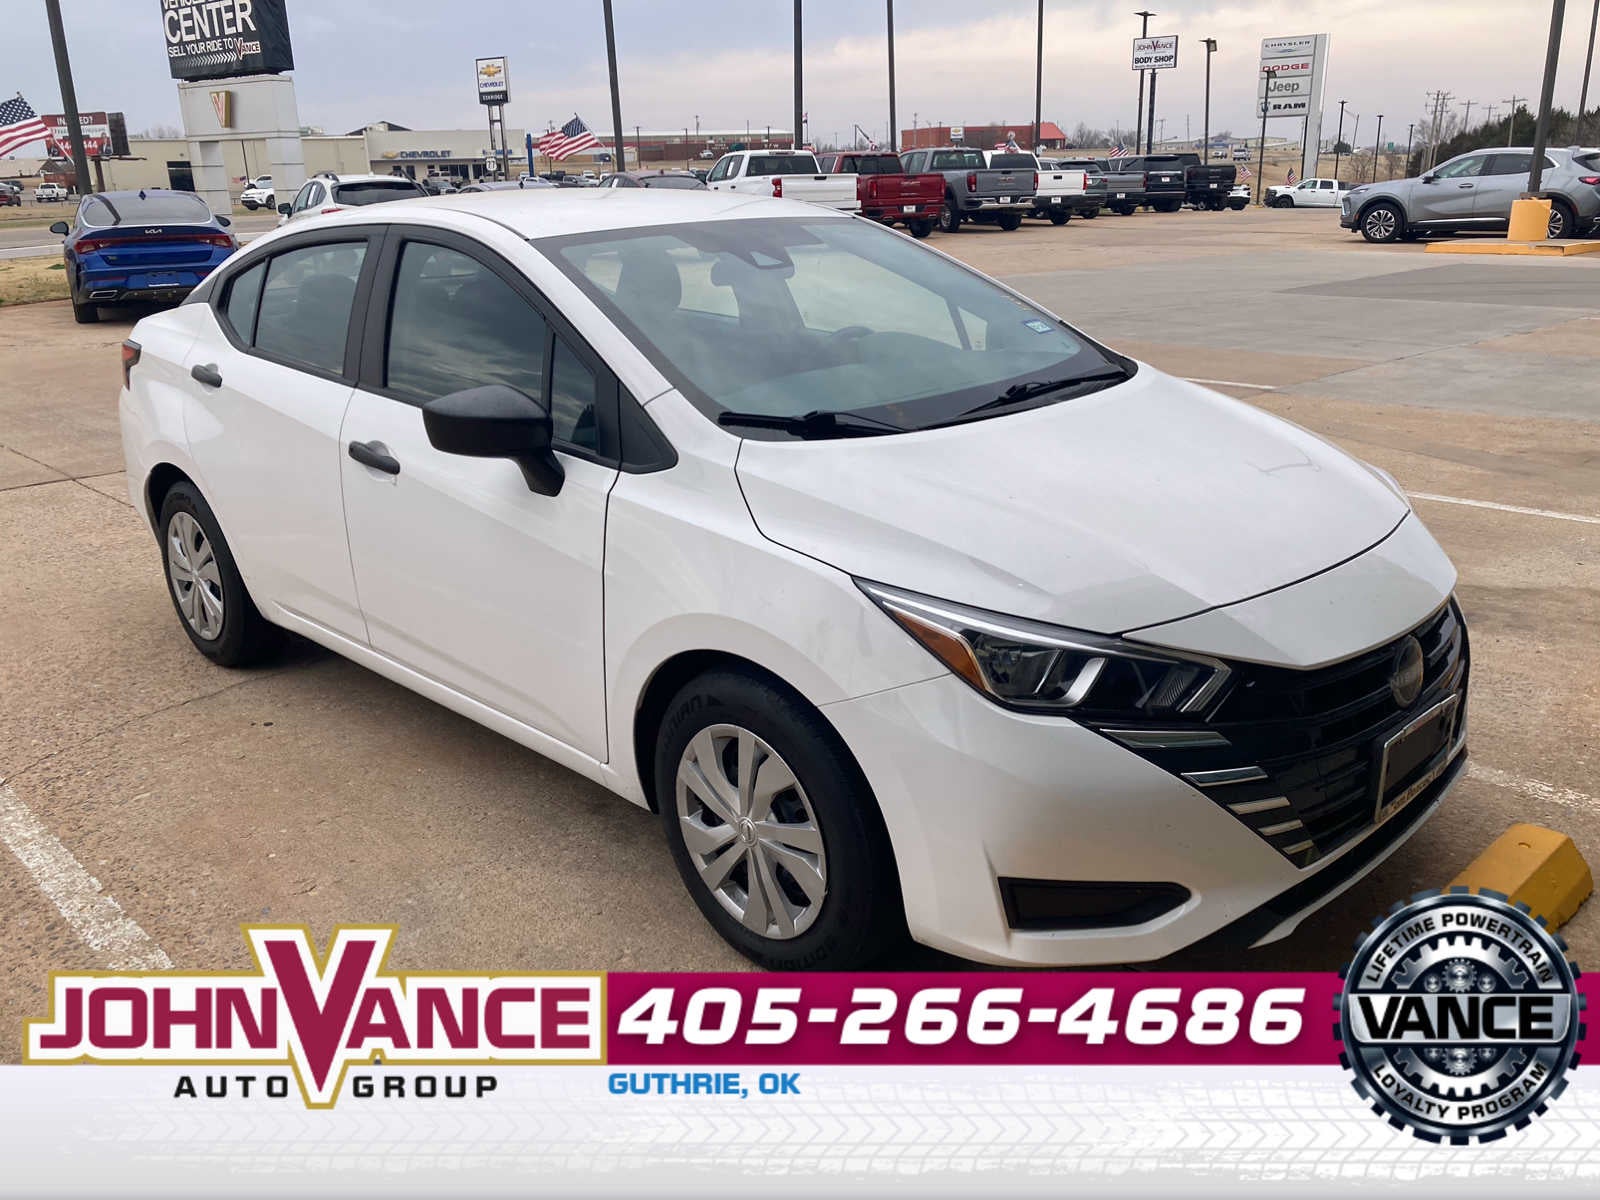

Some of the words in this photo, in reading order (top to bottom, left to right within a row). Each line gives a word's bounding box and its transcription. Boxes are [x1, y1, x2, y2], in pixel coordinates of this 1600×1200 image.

[164, 0, 256, 44] CENTER
[168, 45, 186, 57] SELL
[186, 41, 206, 55] YOUR
[205, 38, 223, 53] RIDE
[223, 38, 234, 50] TO
[234, 37, 260, 60] VANCE
[1134, 57, 1153, 65] BODY
[1154, 55, 1174, 63] SHOP
[1262, 63, 1310, 72] DODGE
[1269, 81, 1300, 93] Jeep
[1273, 102, 1306, 111] RAM
[56, 116, 93, 125] INED?
[400, 150, 451, 159] CHEVROLET
